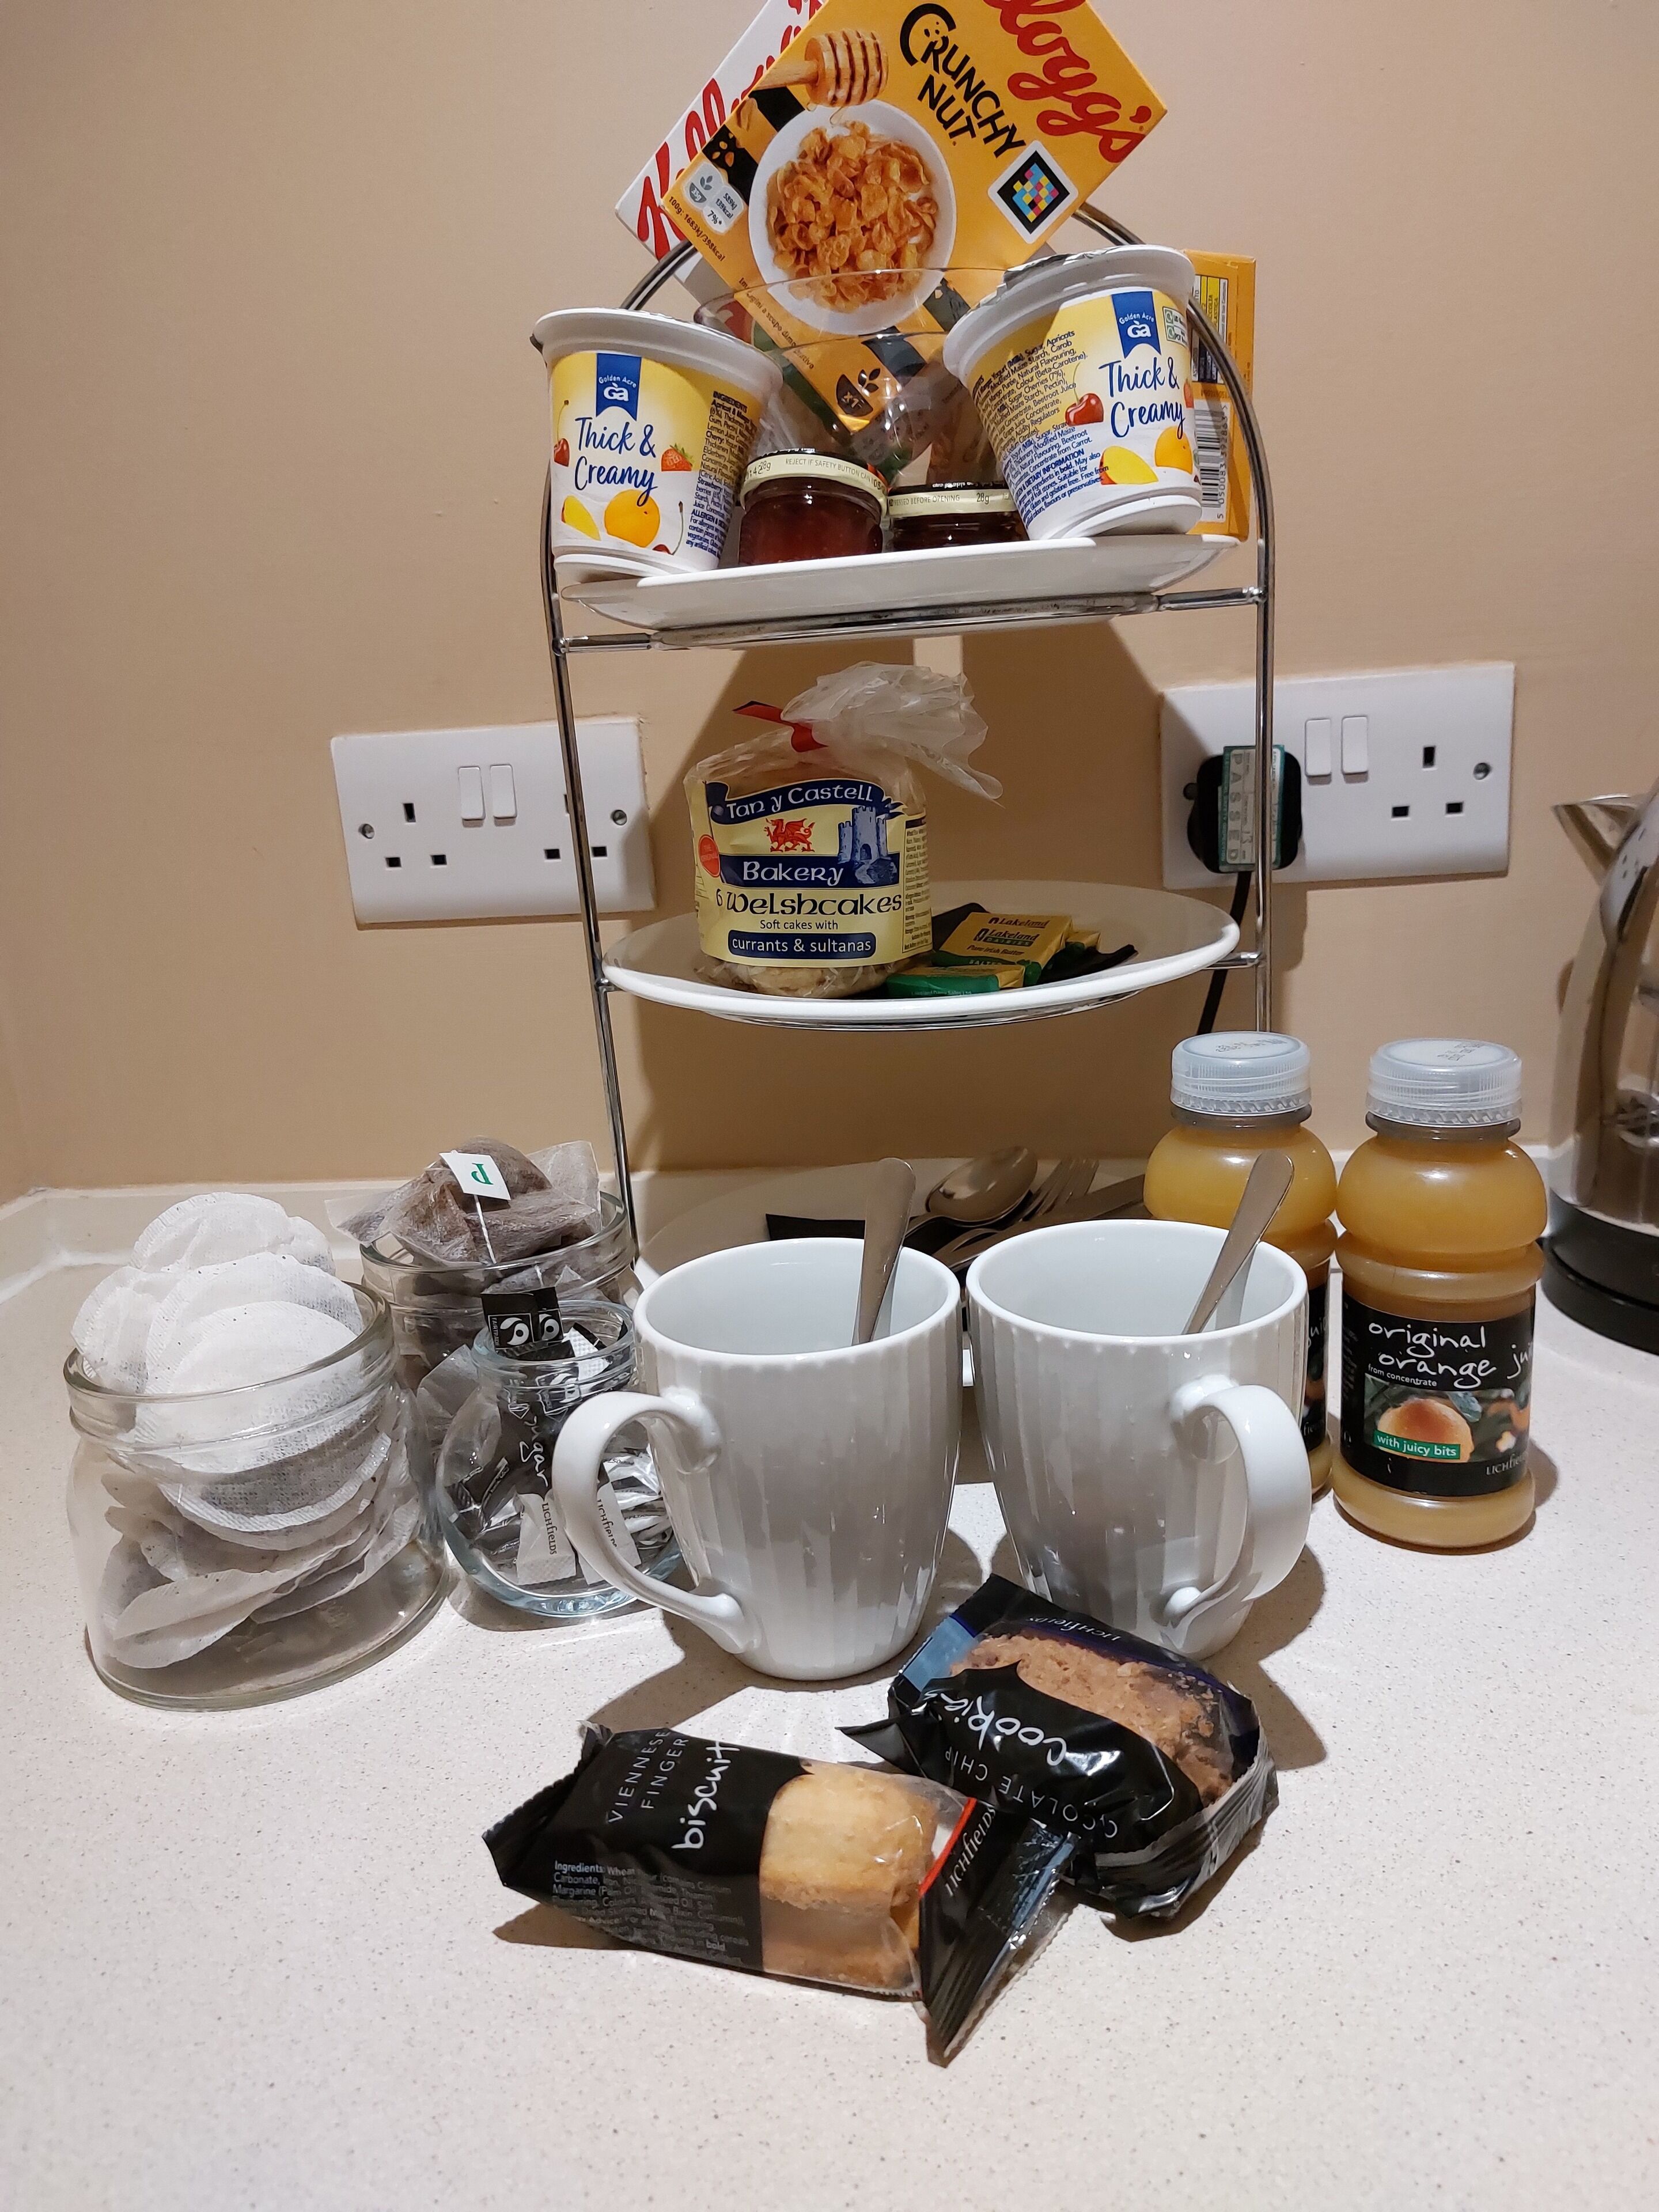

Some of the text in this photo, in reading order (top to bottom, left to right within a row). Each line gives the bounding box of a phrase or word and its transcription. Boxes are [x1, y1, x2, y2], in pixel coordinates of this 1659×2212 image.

[900, 3, 1026, 158] CRUNCHY
[917, 74, 976, 141] NUT
[669, 196, 684, 216] 100g:
[1119, 312, 1154, 325] Golden Acre
[991, 365, 1008, 380] Yogurt
[1044, 329, 1075, 347] Apricots
[1010, 339, 1073, 375] Maize Starch, Carob
[1017, 346, 1077, 379] Natural Flavouring,
[599, 375, 637, 388] Golden Acre
[1014, 374, 1035, 390] Colour
[1023, 377, 1048, 393] Cherries
[1099, 360, 1166, 397] Thick
[1168, 356, 1180, 390] &
[1023, 377, 1067, 403] Starch, Pectin),
[1032, 388, 1059, 407] Beetroot
[1058, 381, 1078, 393] Juice
[1024, 397, 1062, 421] Concentrate,
[1029, 406, 1060, 426] Regulators
[1111, 400, 1186, 439] Creamy
[575, 416, 656, 457] Thick &
[706, 430, 724, 444] Cherry:
[1056, 425, 1077, 437] Maize
[1060, 428, 1088, 445] Beetroot
[815, 459, 836, 469] SAFETY
[838, 464, 860, 476] BUTTON
[861, 472, 871, 482] CAN
[1024, 448, 1085, 486] DIETARY INFORMATION
[1028, 452, 1058, 474] Concentrate
[1056, 445, 1071, 456] from
[1074, 456, 1089, 467] May
[1087, 451, 1101, 461] also
[574, 456, 658, 506] Creamy
[697, 476, 722, 492] Strawberry:
[1056, 467, 1080, 483] Suitable
[1078, 464, 1088, 472] for
[1080, 469, 1094, 480] Free
[1093, 464, 1109, 474] from
[932, 494, 960, 503] OPENING
[976, 493, 990, 505] 28g
[690, 516, 698, 524] For
[691, 508, 715, 522] ALLERGEN
[726, 783, 874, 820] Tan y Castell
[1228, 753, 1243, 862] PASSED
[742, 861, 844, 887] Bakery
[715, 888, 903, 916] 6 Welshcakes
[759, 918, 839, 930] Soft cakes with
[988, 930, 1040, 940] Lakeland
[998, 918, 1050, 928] Lakeland
[732, 938, 872, 952] currants & sultanas
[1368, 1322, 1486, 1358] original
[1368, 1363, 1437, 1387] from concentrate
[1378, 1352, 1497, 1389] orange
[1377, 1434, 1457, 1456] with juicy bits
[922, 1689, 1068, 1767] Cookies
[608, 1729, 672, 1824] VIENNESE
[640, 1737, 689, 1809] FINGER
[945, 1749, 988, 1782] CHIP
[672, 1741, 740, 1849] biscuit
[551, 1884, 596, 1895] Margarine
[553, 1871, 600, 1885] Carbonate,
